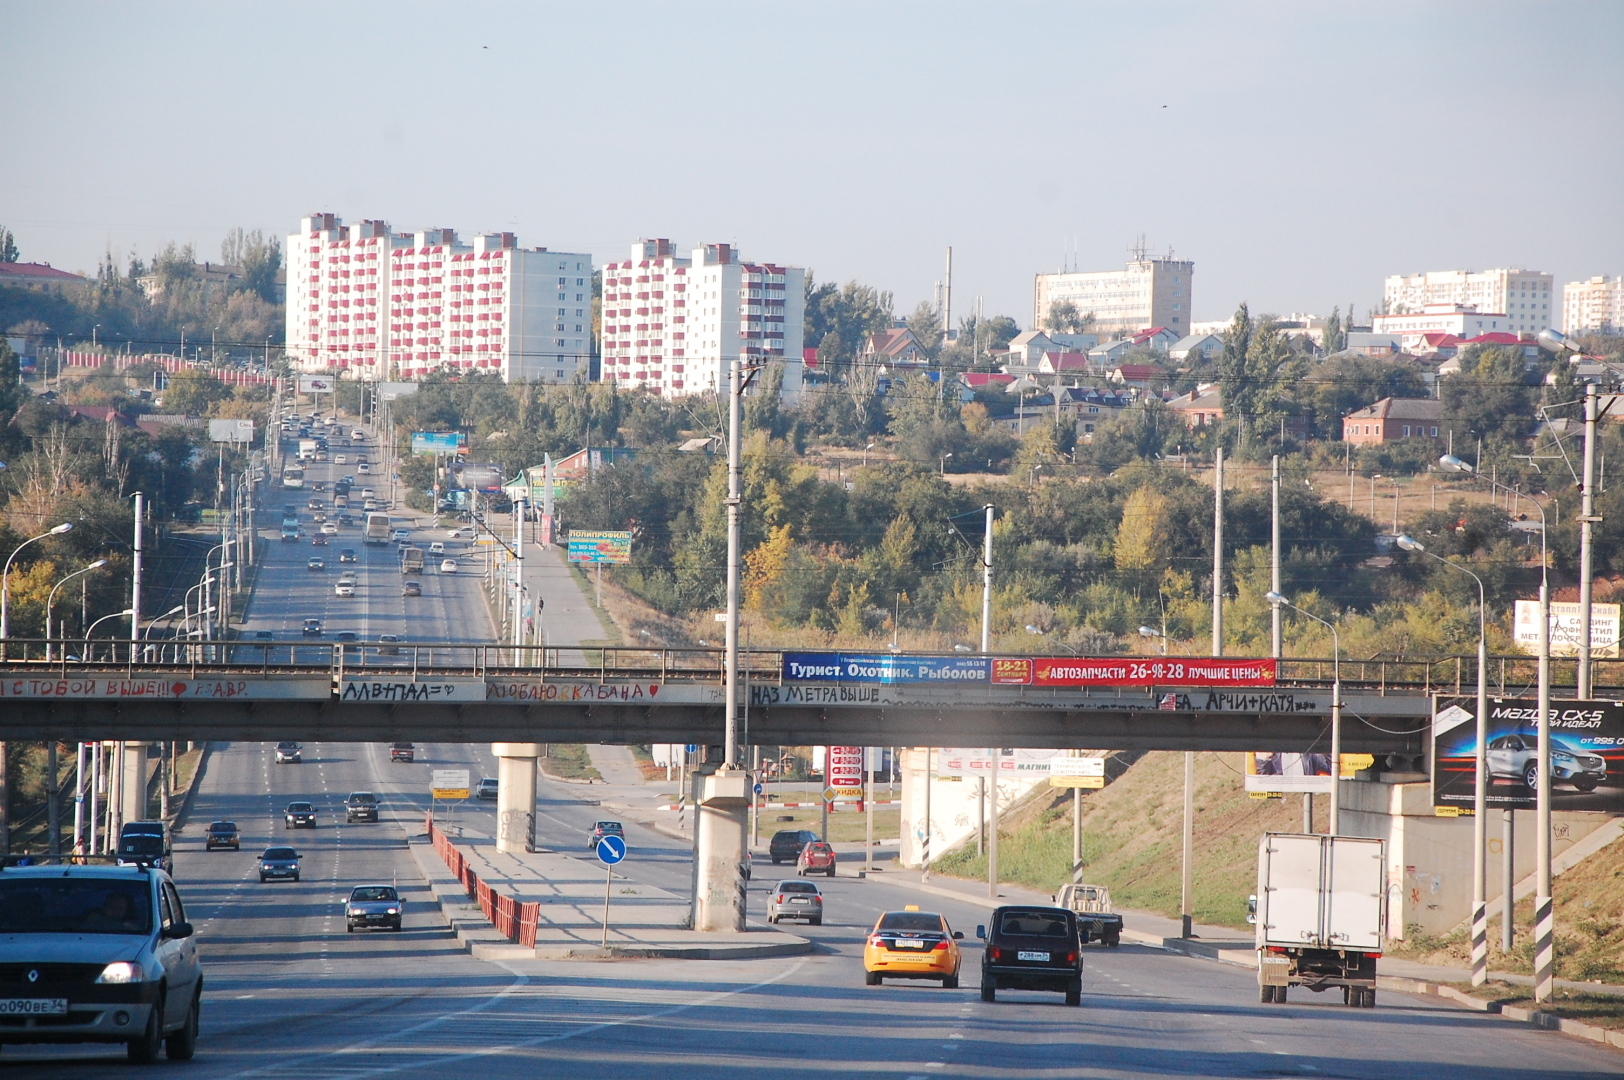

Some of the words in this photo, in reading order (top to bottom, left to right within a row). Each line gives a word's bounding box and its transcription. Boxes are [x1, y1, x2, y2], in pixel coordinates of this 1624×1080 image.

[570, 531, 630, 539] ПОЛИПРОФИЛЬ
[1569, 618, 1613, 626] САДИНГ
[1550, 626, 1613, 635] ПРОФНСТИЛ
[790, 662, 844, 678] Турист.
[848, 664, 914, 679] Охотник.
[918, 665, 986, 680] Рыболов
[996, 660, 1028, 671] 18-21
[1050, 667, 1126, 679] АВТОЗАПЧАСТИ
[1129, 663, 1184, 679] 26-98-28
[1188, 667, 1230, 680] ЛУЧШИЕ
[1231, 667, 1260, 681] ЦЕНЫ
[29, 680, 96, 695] ТОБОЙ
[486, 684, 557, 700] ЛЮБЛЮ
[572, 684, 643, 701] КАБАНА
[785, 686, 837, 702] МЕТРА
[840, 686, 880, 702] ВЫШЕ
[1561, 710, 1604, 721] CX-5
[1562, 719, 1602, 728] ИДЕАЛ
[1593, 737, 1614, 745] 995
